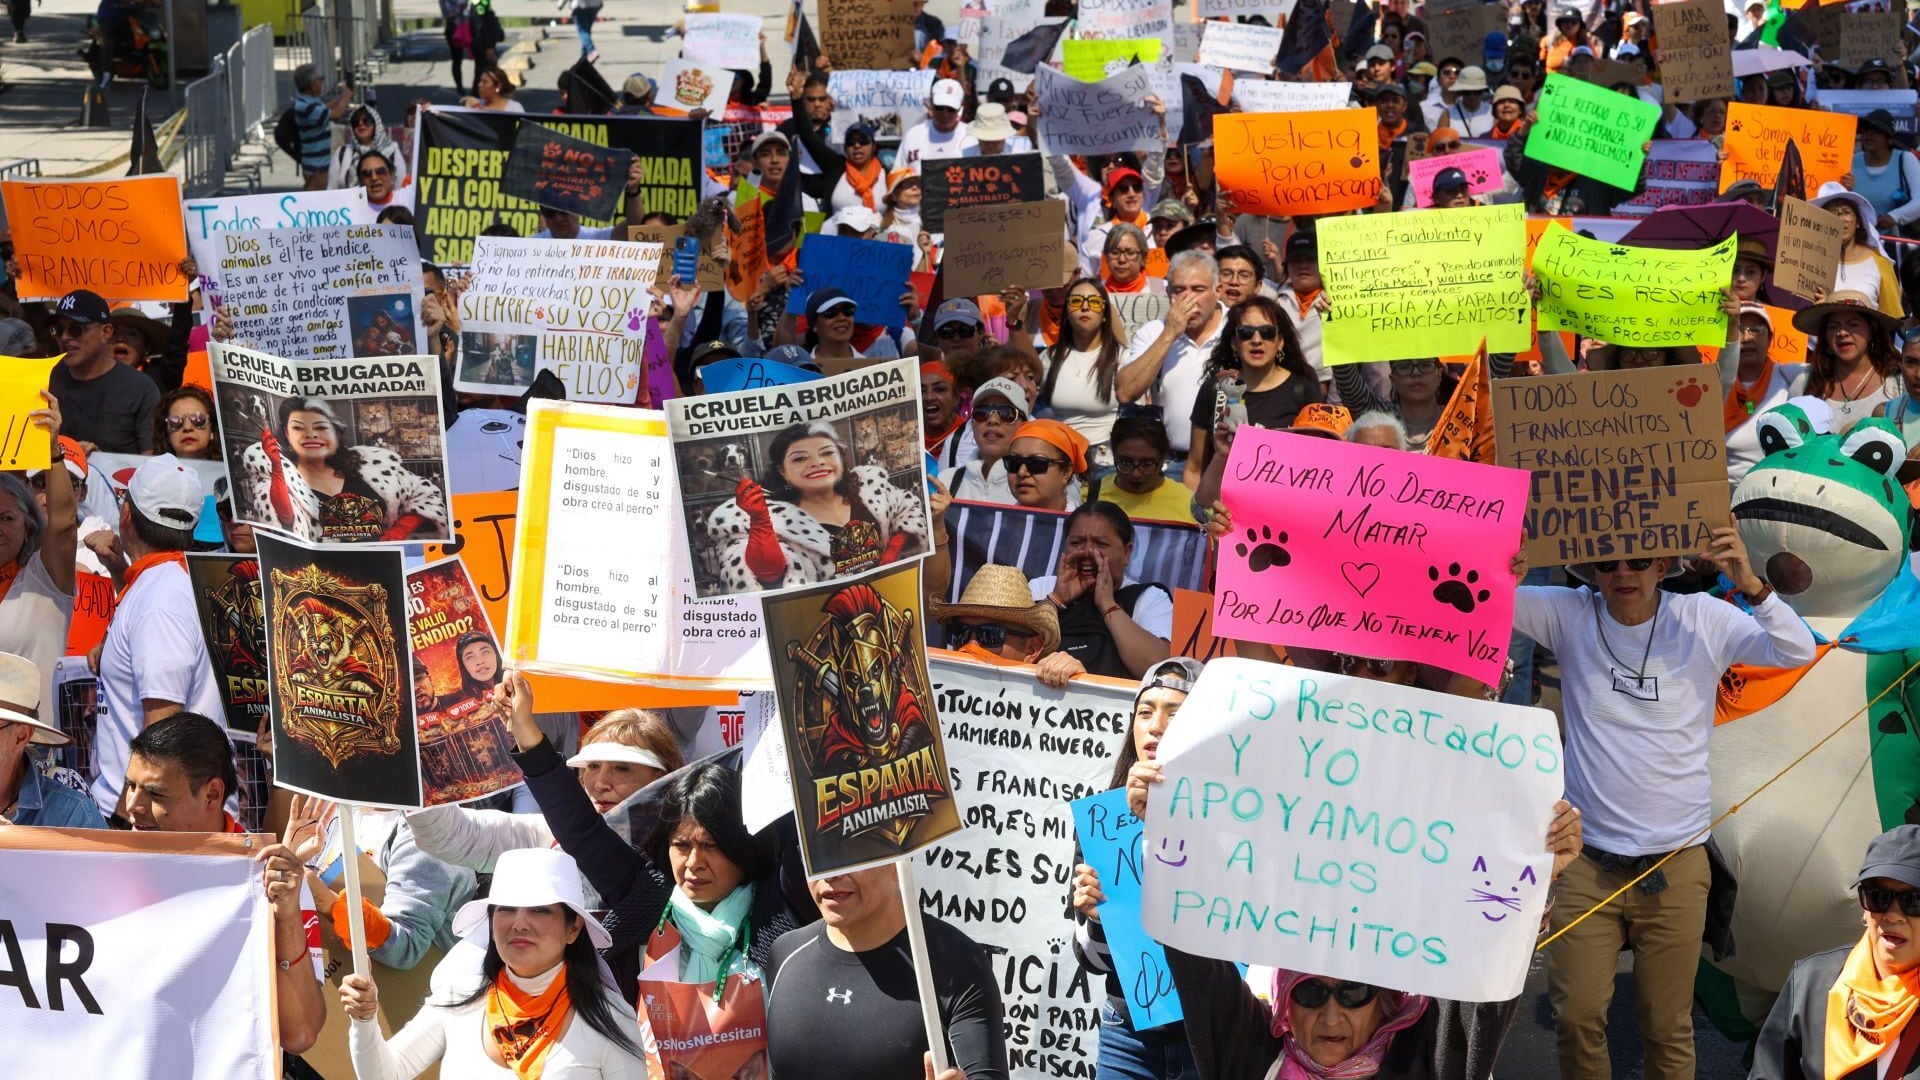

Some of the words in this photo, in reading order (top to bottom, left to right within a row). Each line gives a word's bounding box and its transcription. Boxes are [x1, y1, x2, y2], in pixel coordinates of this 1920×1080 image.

[1233, 119, 1361, 155] Justicia
[564, 149, 595, 166] NO
[969, 166, 1001, 182] NO
[24, 185, 130, 211] TODOS
[278, 195, 353, 227] Somos
[33, 216, 141, 245] SOMOS
[226, 234, 261, 255] Dios
[268, 232, 284, 248] te
[347, 225, 384, 239] cuides
[389, 229, 397, 239] a
[399, 226, 414, 240] los
[1386, 226, 1472, 244] Fraudulenta
[221, 252, 272, 269] animales
[299, 247, 314, 262] te
[478, 239, 490, 258] Si
[494, 243, 527, 263] ignoras
[532, 247, 543, 258] su
[608, 244, 662, 260] RECUERDO
[1557, 234, 1688, 271] RESCATE
[225, 273, 244, 289] Es
[245, 274, 258, 285] un
[264, 270, 284, 283] ser
[289, 265, 317, 281] vivo
[322, 264, 341, 286] que
[345, 257, 385, 272] siente
[389, 255, 409, 273] que
[476, 260, 486, 276] Si
[488, 263, 502, 276] no
[507, 265, 520, 278] los
[592, 266, 603, 278] TE
[606, 266, 657, 281] TRADUZCO
[223, 286, 268, 307] depende
[274, 282, 288, 297] de
[293, 280, 305, 295] ti
[311, 279, 329, 298] que
[332, 272, 374, 290] confía
[377, 273, 390, 284] en
[483, 282, 497, 293] no
[502, 281, 517, 296] los
[572, 285, 593, 309] YO
[600, 285, 636, 313] SOY
[1426, 297, 1448, 312] YA
[1457, 292, 1497, 307] PARA
[1502, 291, 1529, 305] LOS
[1577, 284, 1614, 300] ES
[244, 301, 268, 316] ama
[271, 298, 288, 312] sin
[293, 294, 345, 312] condiciones
[463, 294, 539, 325] SIEMPRE
[546, 304, 569, 326] SU
[578, 310, 625, 333] VOZ
[1371, 307, 1526, 333] FRANCISCANITOS!
[223, 350, 293, 381] ¡CRUELA
[297, 362, 424, 382] BRUGADA
[620, 338, 643, 367] POR
[227, 368, 288, 394] DEVUELVE
[290, 385, 301, 396] A
[304, 384, 329, 396] LA
[332, 380, 426, 396] MANADA!!
[683, 392, 793, 421] ¡CRUELA
[797, 367, 904, 407] BRUGADA
[1500, 380, 1577, 412] TODOS
[1592, 380, 1638, 408] LOS
[689, 413, 785, 436] DEVUELVE
[789, 411, 802, 425] A
[807, 404, 831, 421] LA
[834, 386, 906, 416] MANADA!!
[1509, 411, 1670, 444] FRANCISCANITOS
[1679, 409, 1693, 435] Y
[613, 451, 633, 466] hizo
[650, 456, 660, 468] al
[1509, 438, 1718, 470] FRANCISGATITOS
[565, 463, 609, 480] hombre,
[653, 475, 660, 486] y
[1530, 465, 1678, 504] TIENEN
[562, 495, 588, 509] obra
[615, 501, 624, 512] al
[563, 479, 621, 495] disgustado
[627, 486, 639, 498] de
[646, 490, 660, 500] su
[323, 524, 382, 536] ESPARTA
[1522, 500, 1661, 542] NOMBRE
[1687, 500, 1703, 520] E
[1559, 522, 1714, 561] HISTORIA
[683, 610, 758, 624] disgustado
[682, 627, 714, 639] obra
[716, 626, 747, 639] creó
[749, 626, 762, 639] al
[297, 686, 375, 719] ESPARTA
[303, 705, 367, 725] ANIMALISTA
[1040, 732, 1113, 759] RIVERO.
[1228, 733, 1252, 776] Y
[1298, 734, 1360, 787] YO
[813, 744, 946, 833] ESPARTA
[842, 792, 931, 838] ANIMALISTA
[1043, 816, 1066, 840] MI
[1169, 775, 1456, 866] APOYAMOS
[1031, 852, 1071, 886] SU
[1226, 838, 1255, 876] A
[1294, 852, 1379, 895] LOS
[919, 887, 1027, 924] MANDO
[1040, 1028, 1088, 1056] DEL
